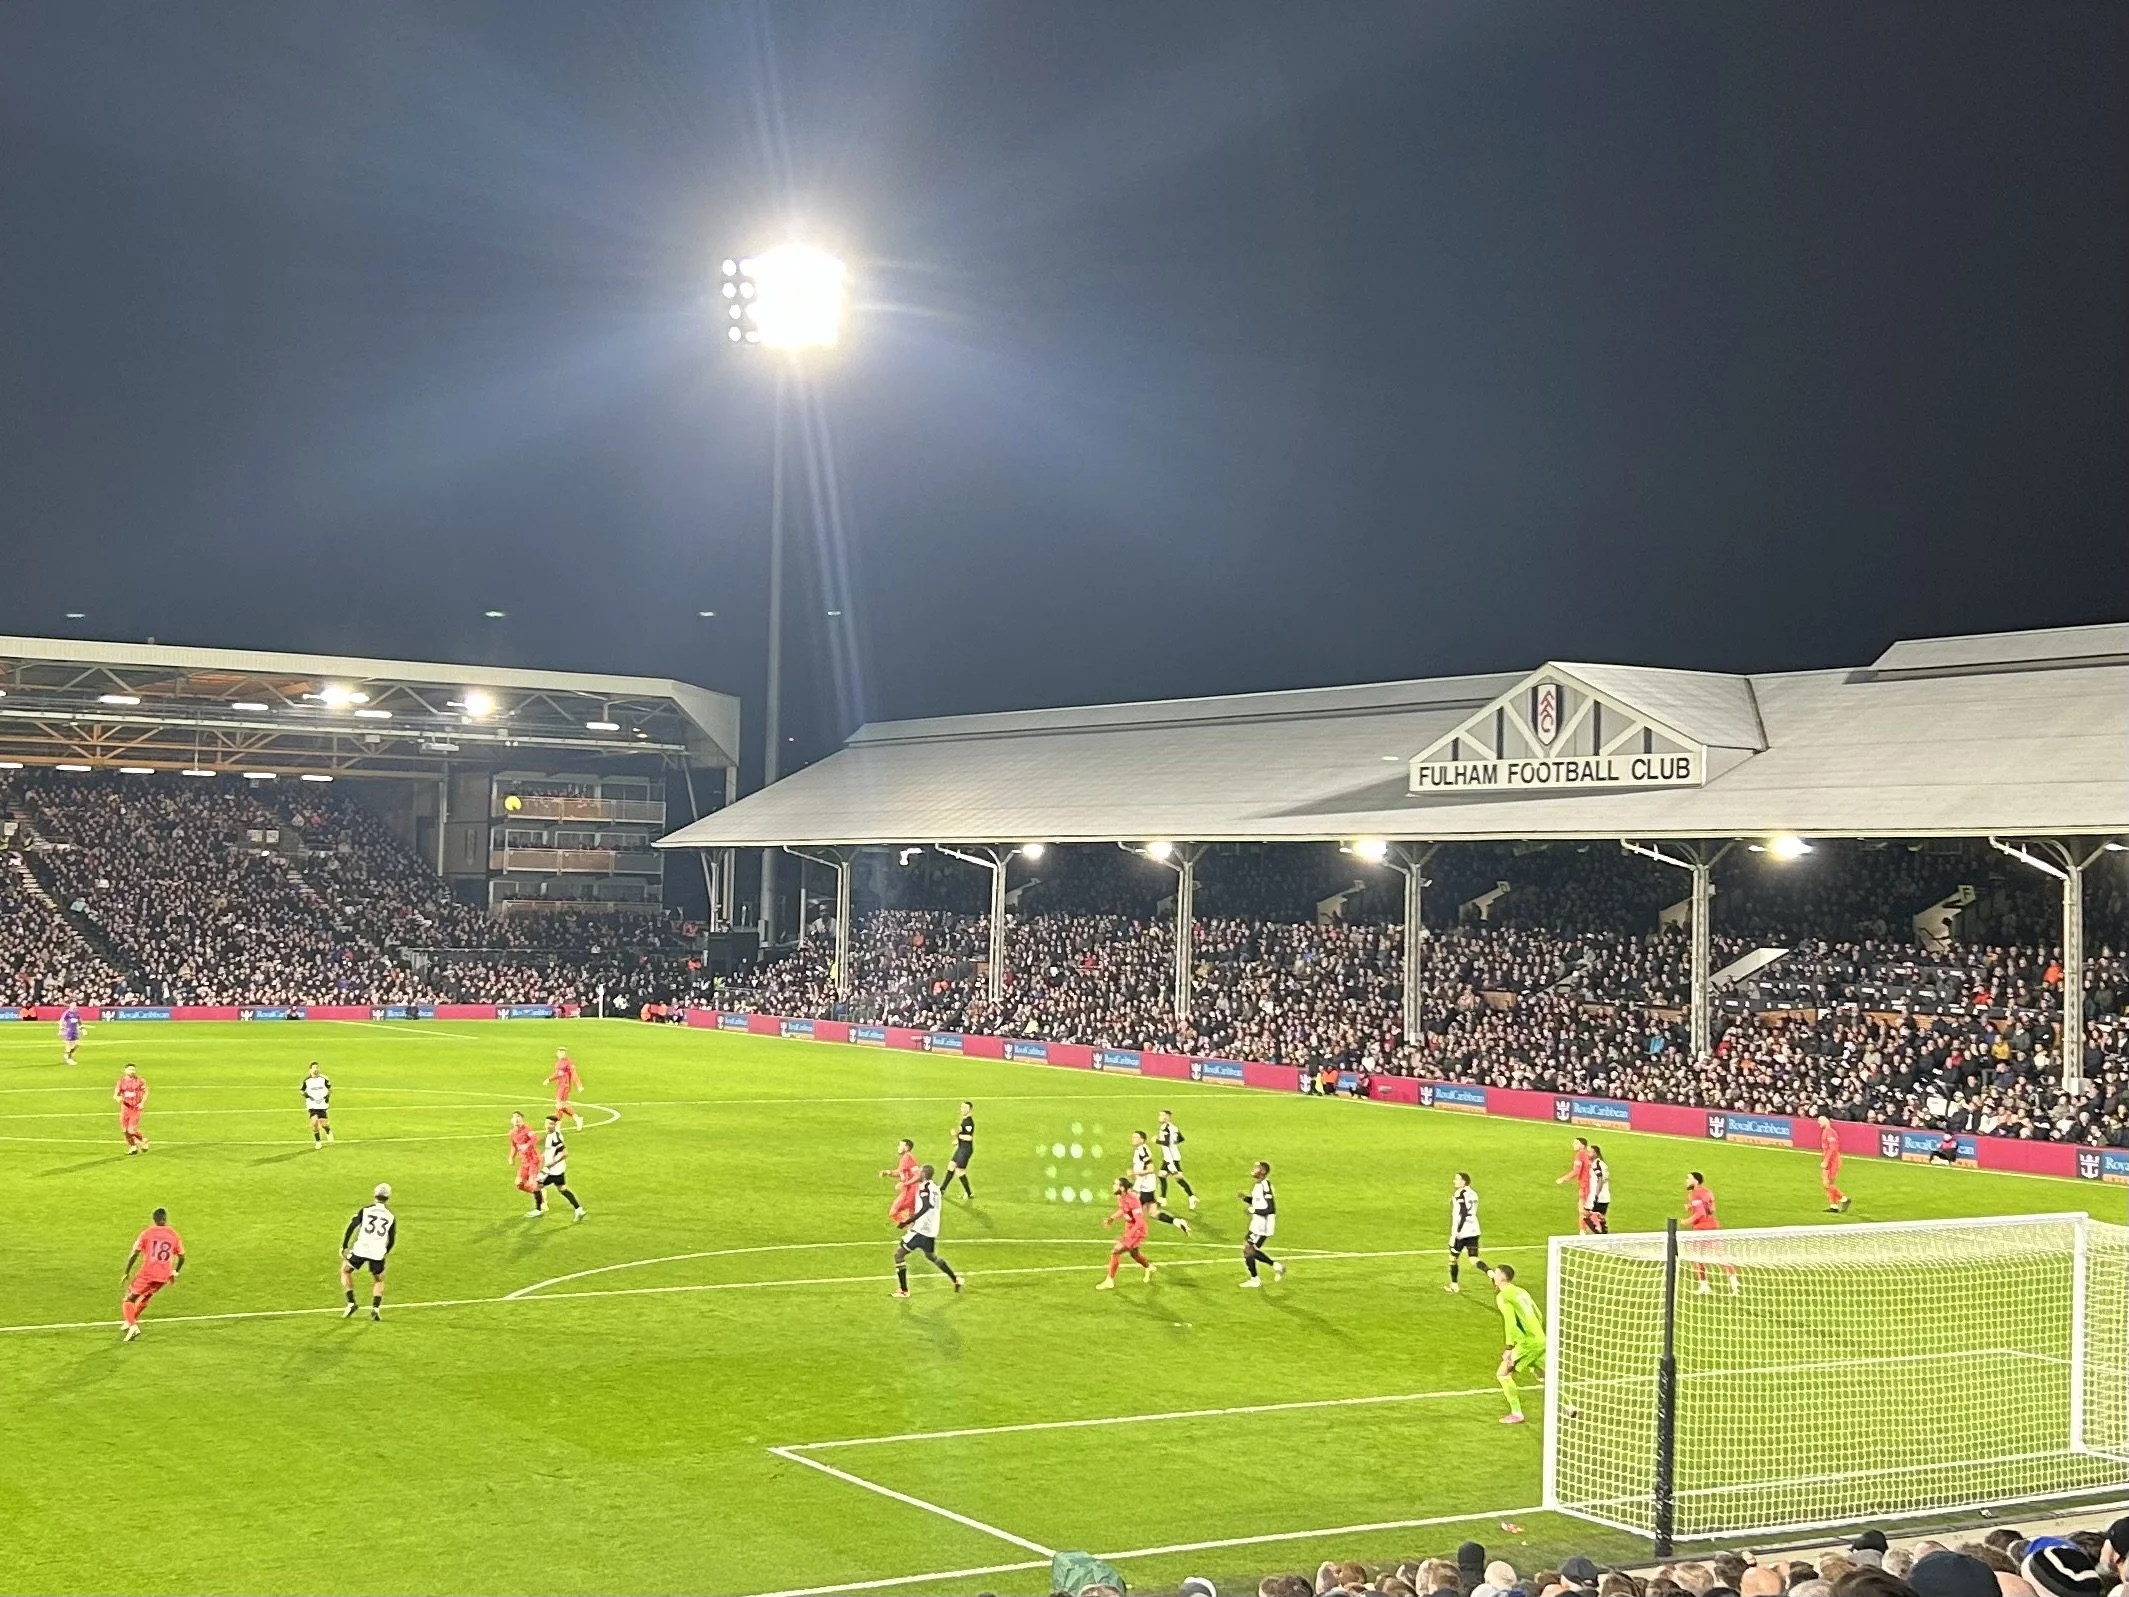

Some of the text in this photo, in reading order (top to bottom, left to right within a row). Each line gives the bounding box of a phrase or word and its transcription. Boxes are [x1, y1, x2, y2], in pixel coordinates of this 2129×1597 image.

[1419, 757, 1690, 786] FULHAM FOOTBALL CLUB
[364, 1214, 390, 1237] 33
[151, 1240, 171, 1262] 18
